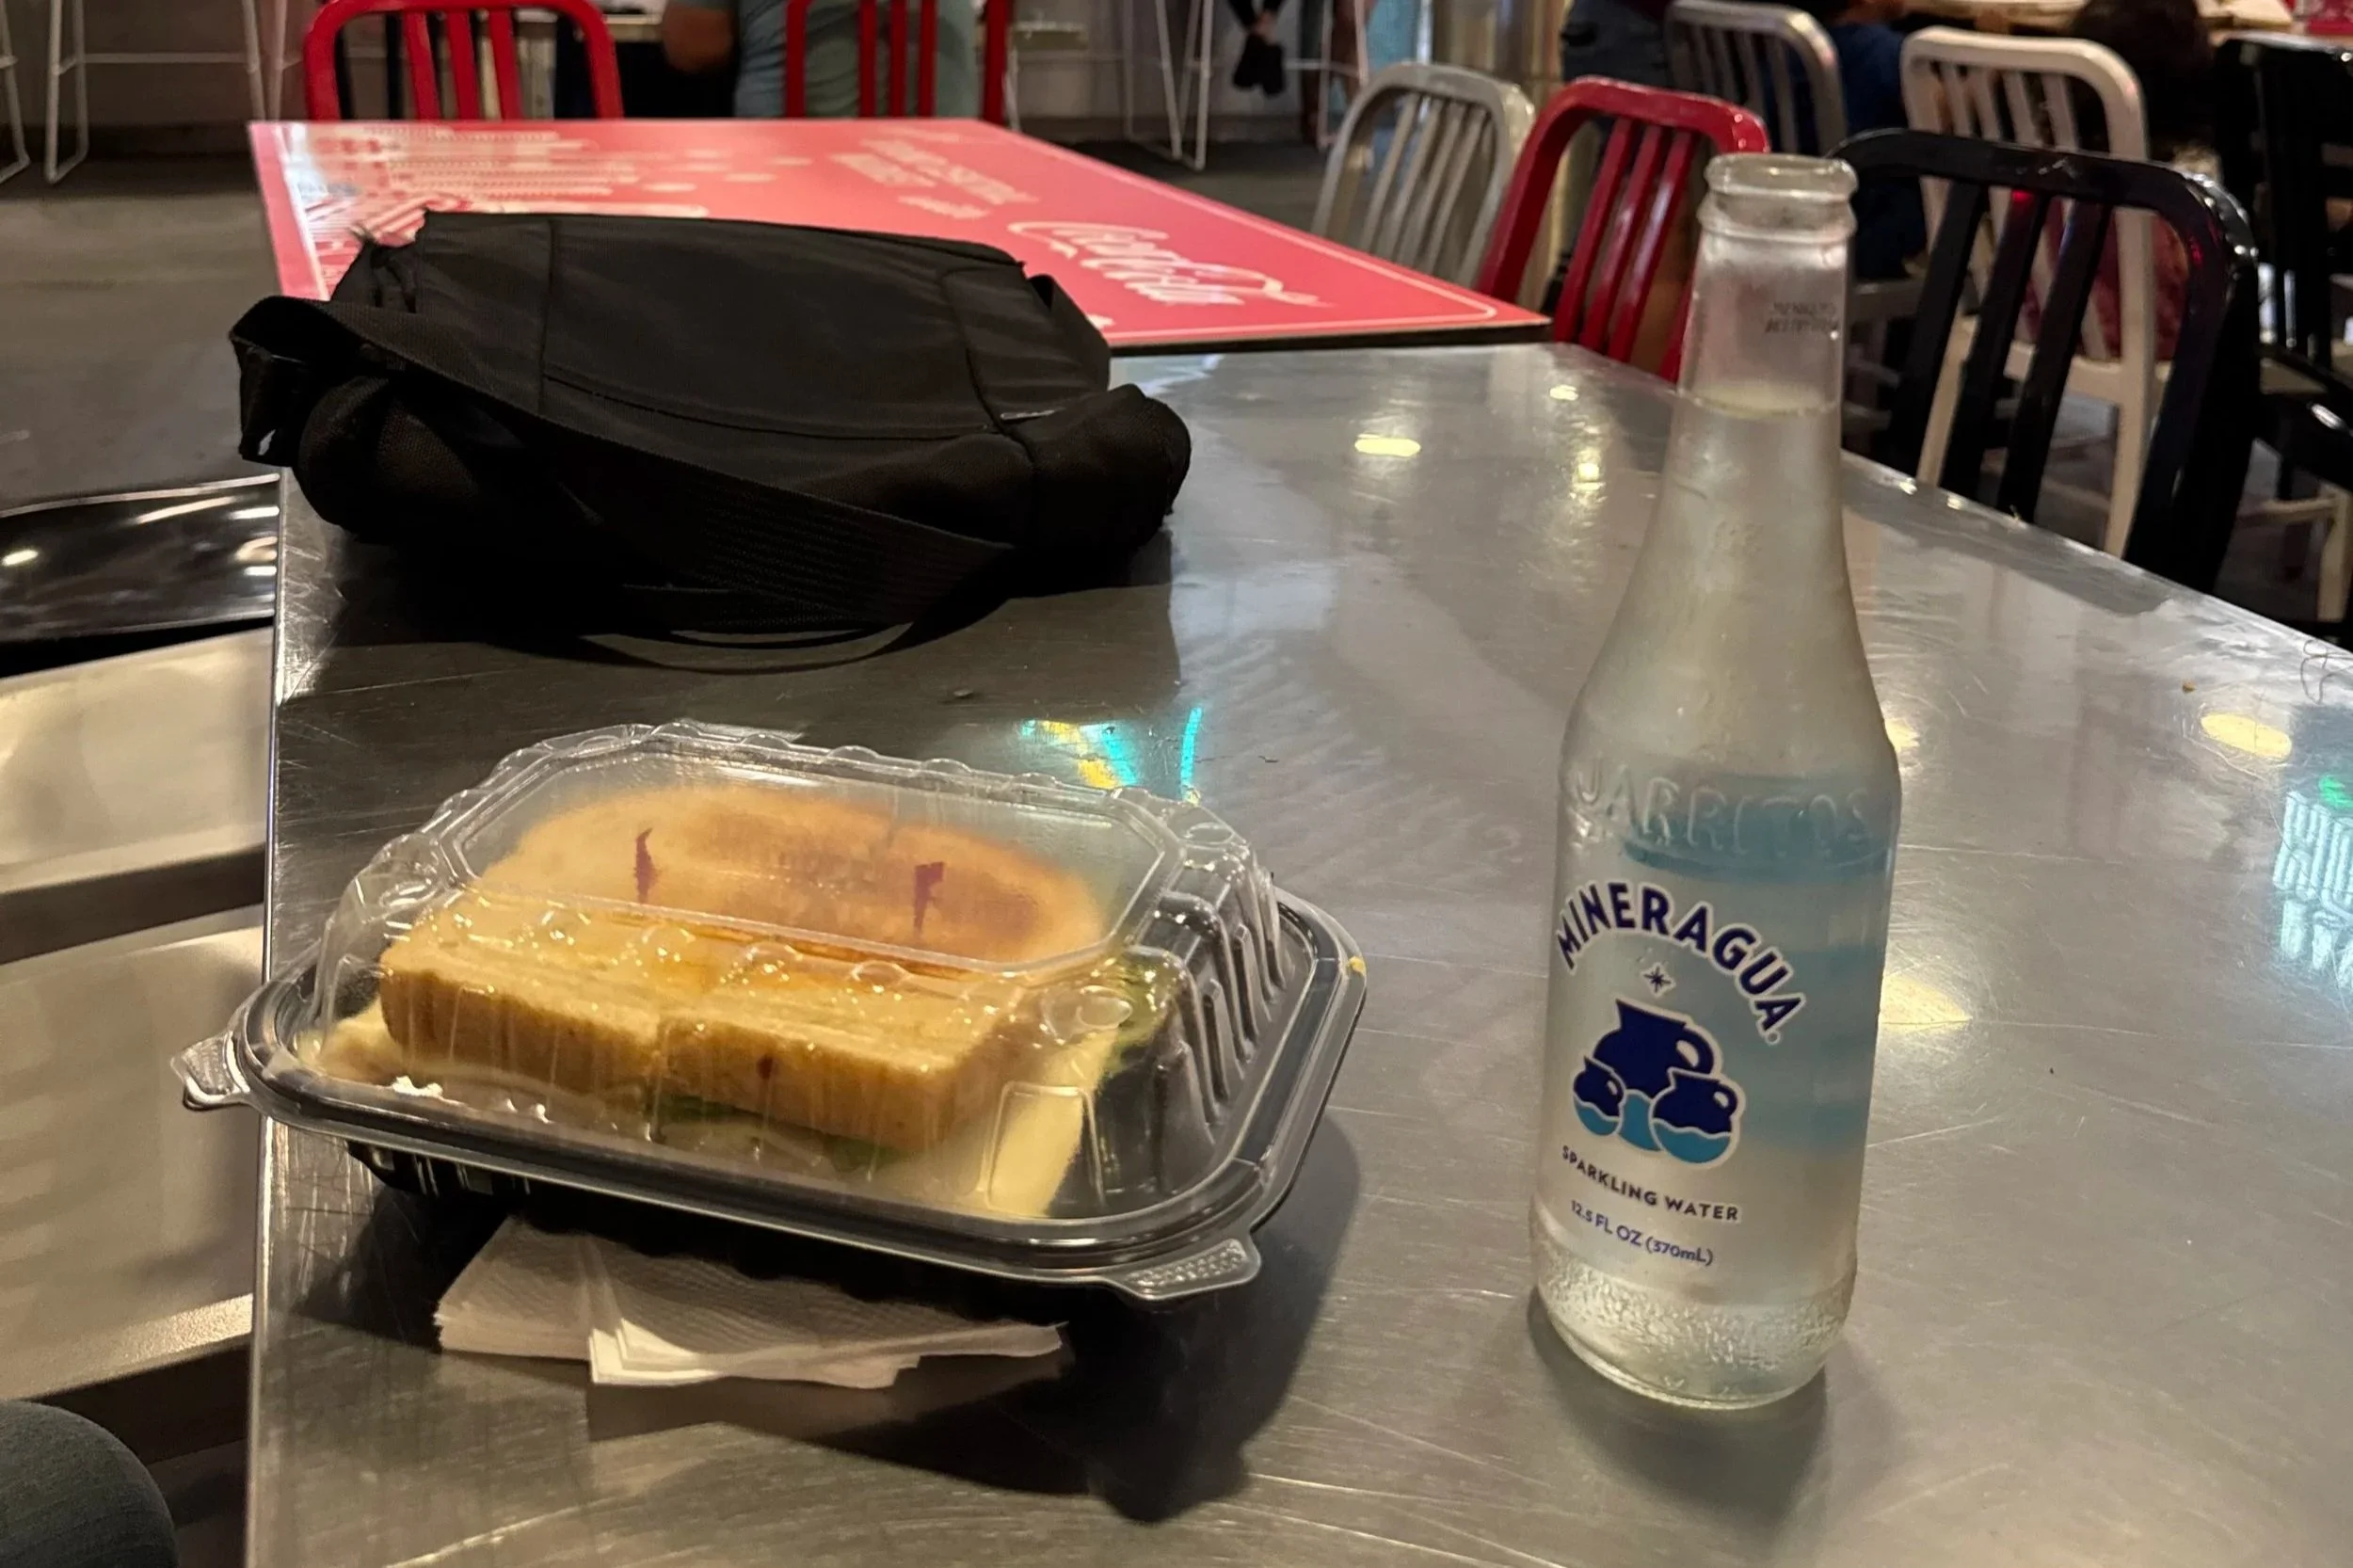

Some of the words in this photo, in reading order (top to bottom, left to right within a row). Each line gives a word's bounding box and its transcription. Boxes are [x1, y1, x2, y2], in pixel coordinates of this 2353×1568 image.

[1556, 881, 1802, 1032] MINERAGUA
[1561, 1144, 1657, 1207] SPARKLING
[1663, 1195, 1739, 1222] WATER
[1571, 1199, 1593, 1224] 12.5
[1594, 1212, 1613, 1235] FL
[1616, 1224, 1642, 1247] OZ
[1645, 1235, 1714, 1267] (370mL)
